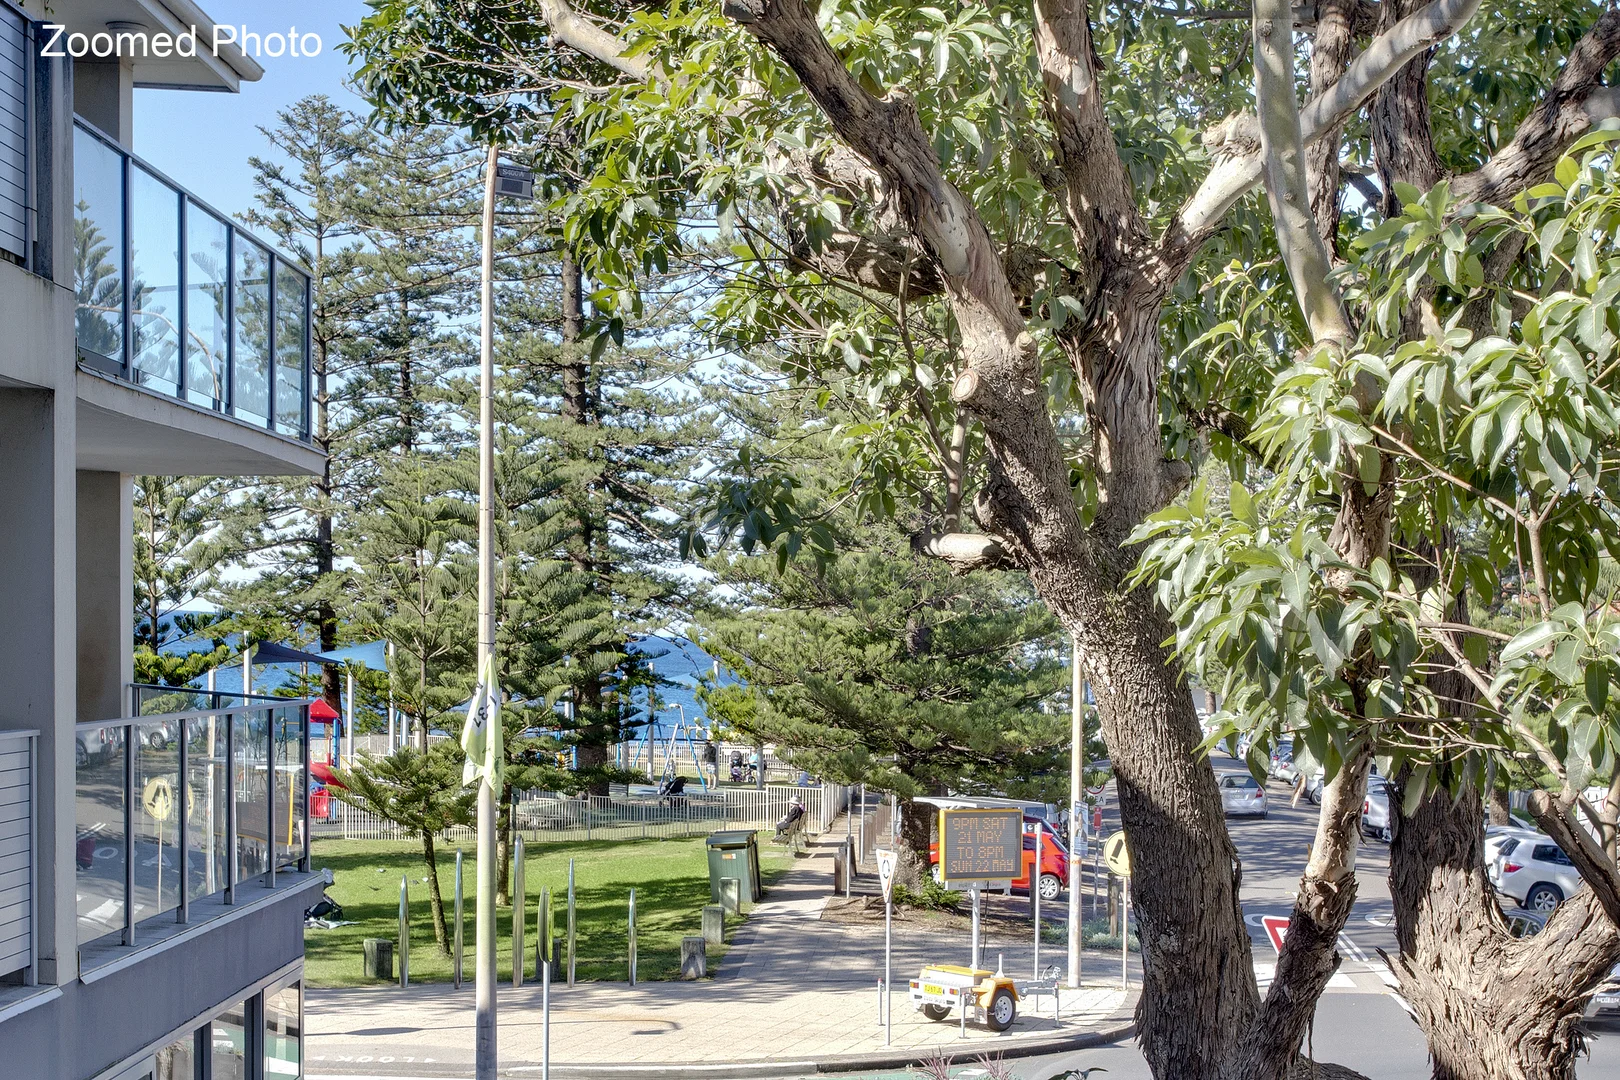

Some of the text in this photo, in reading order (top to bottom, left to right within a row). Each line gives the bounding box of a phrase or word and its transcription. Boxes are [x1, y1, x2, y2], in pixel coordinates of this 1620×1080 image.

[952, 816, 1009, 830] 9PM SAT
[957, 830, 1003, 844] 21 MAY
[957, 845, 1004, 860] TO 8PM
[950, 859, 1015, 873] SUN 22 MAY
[335, 1055, 416, 1063] LOOK
